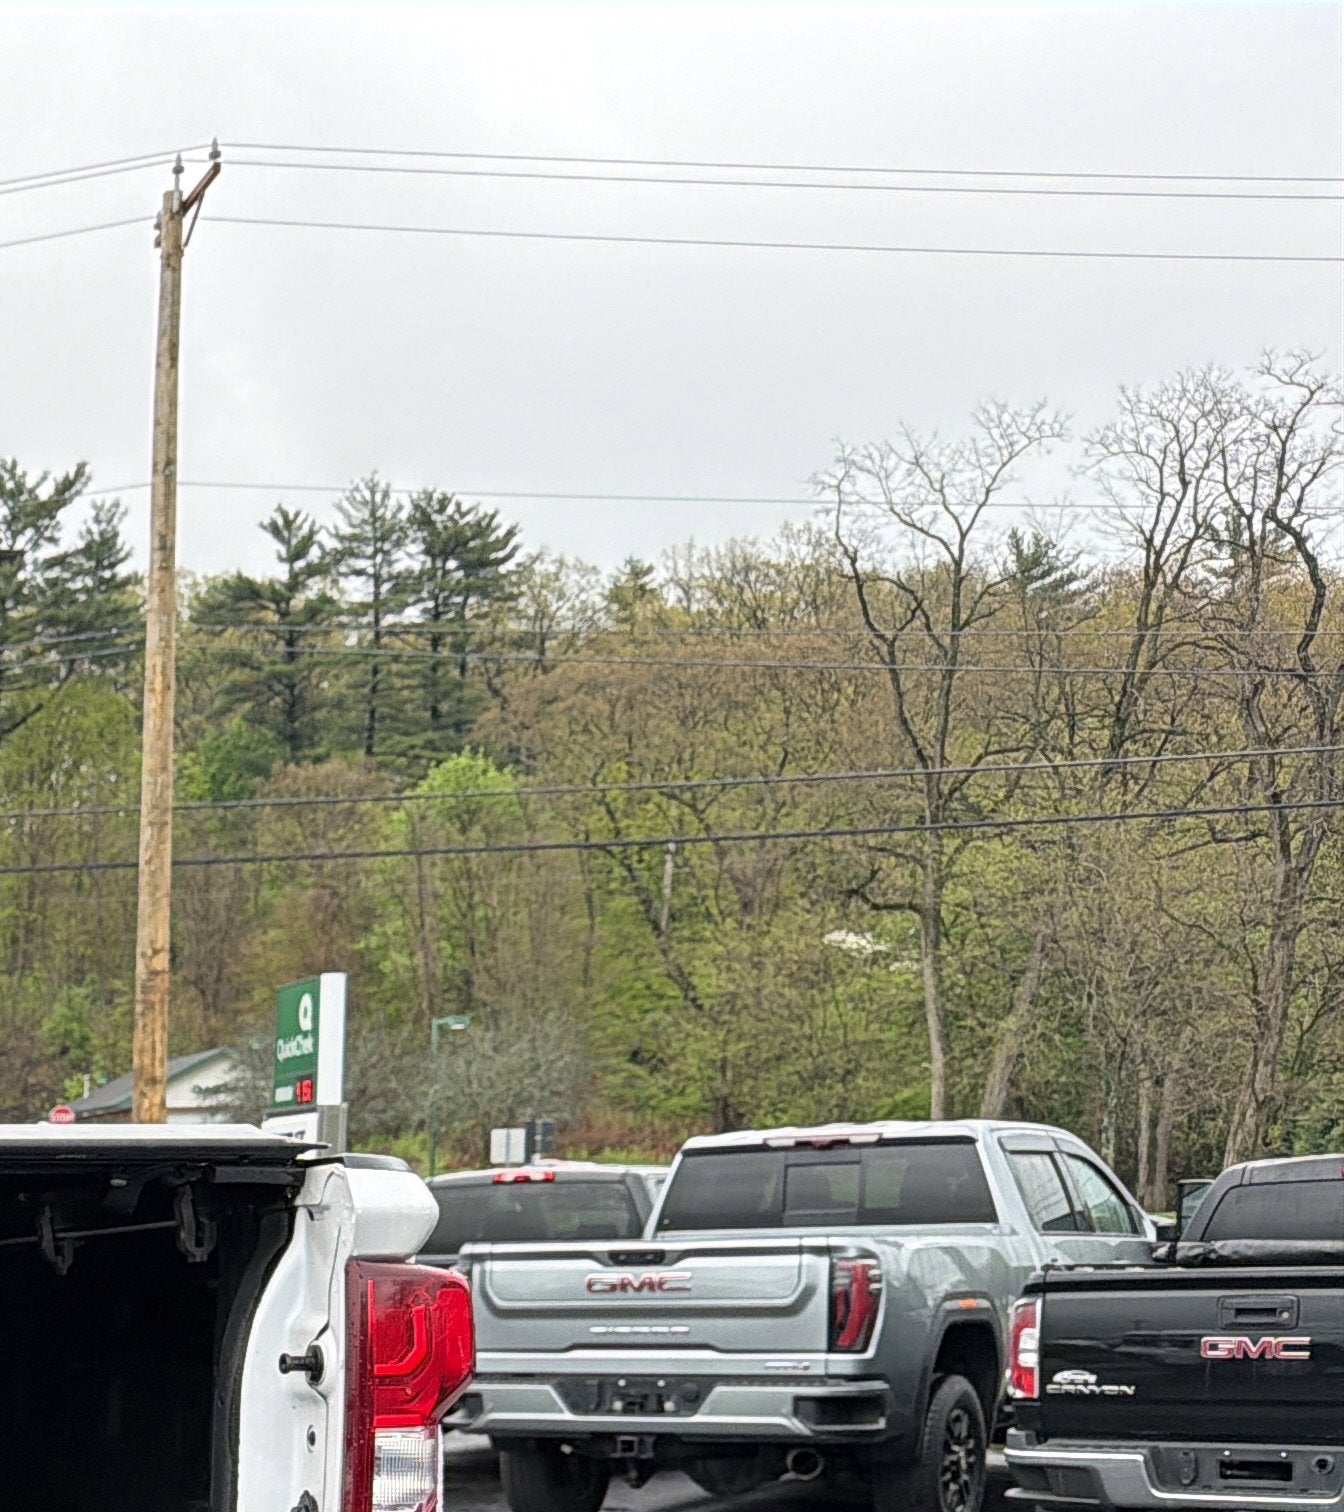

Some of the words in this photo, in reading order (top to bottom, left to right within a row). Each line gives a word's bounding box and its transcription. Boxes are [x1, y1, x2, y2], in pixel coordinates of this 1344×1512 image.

[586, 1272, 692, 1293] GMC
[1200, 1336, 1311, 1360] GMC
[1046, 1384, 1136, 1395] CANYON
